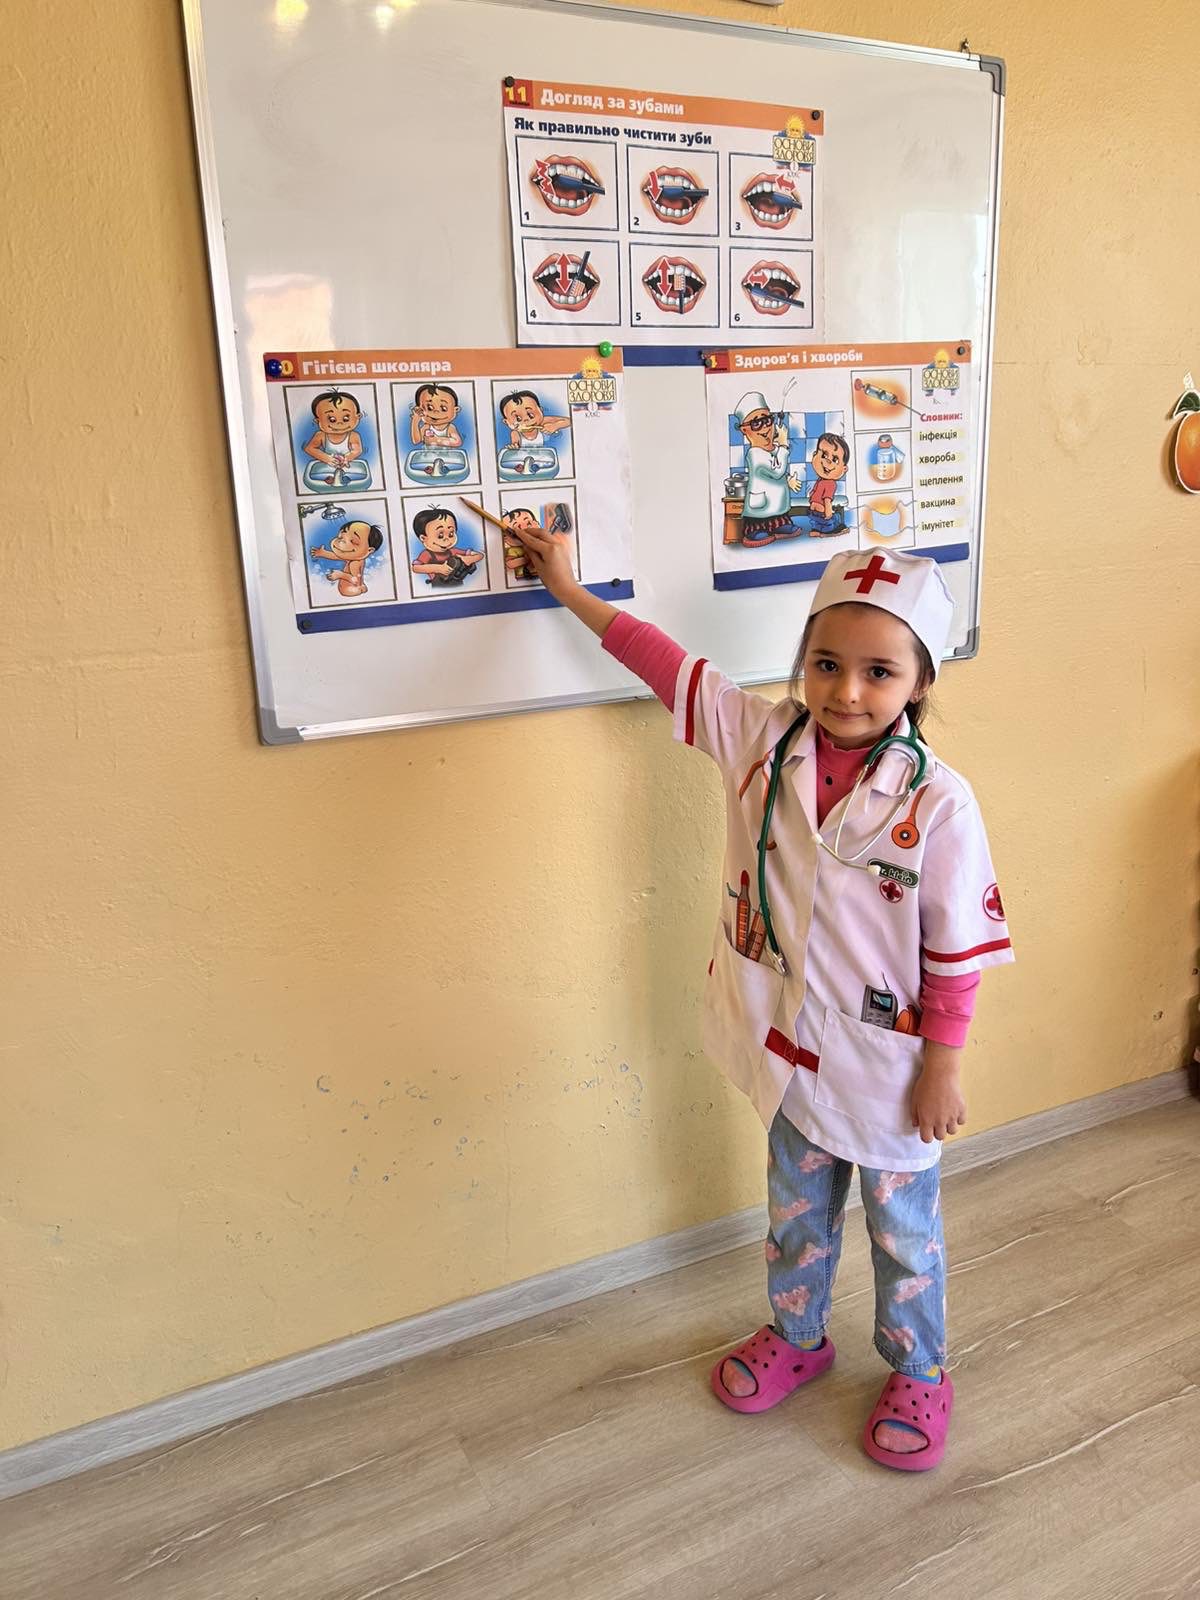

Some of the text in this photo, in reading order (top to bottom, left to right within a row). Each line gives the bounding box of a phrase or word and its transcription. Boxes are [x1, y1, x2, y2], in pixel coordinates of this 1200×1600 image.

[505, 86, 526, 102] 11
[541, 88, 684, 115] Догляд за зубами
[514, 117, 712, 145] Як правильно чистити зуби
[525, 212, 530, 220] 1
[633, 217, 640, 226] 2
[735, 222, 741, 230] 3
[530, 310, 537, 319] 4
[635, 313, 641, 321] 5
[734, 313, 741, 322] 6
[735, 350, 863, 368] Здоров'я і хвороби
[302, 360, 452, 375] Гігієна школяра
[569, 380, 614, 391] ОСНОВИ
[920, 413, 962, 422] Словник:
[919, 430, 957, 442] інфекція
[919, 452, 956, 464] хвороба
[920, 475, 963, 487] щеплення
[920, 498, 955, 509] вакцина
[921, 520, 954, 532] імунітет
